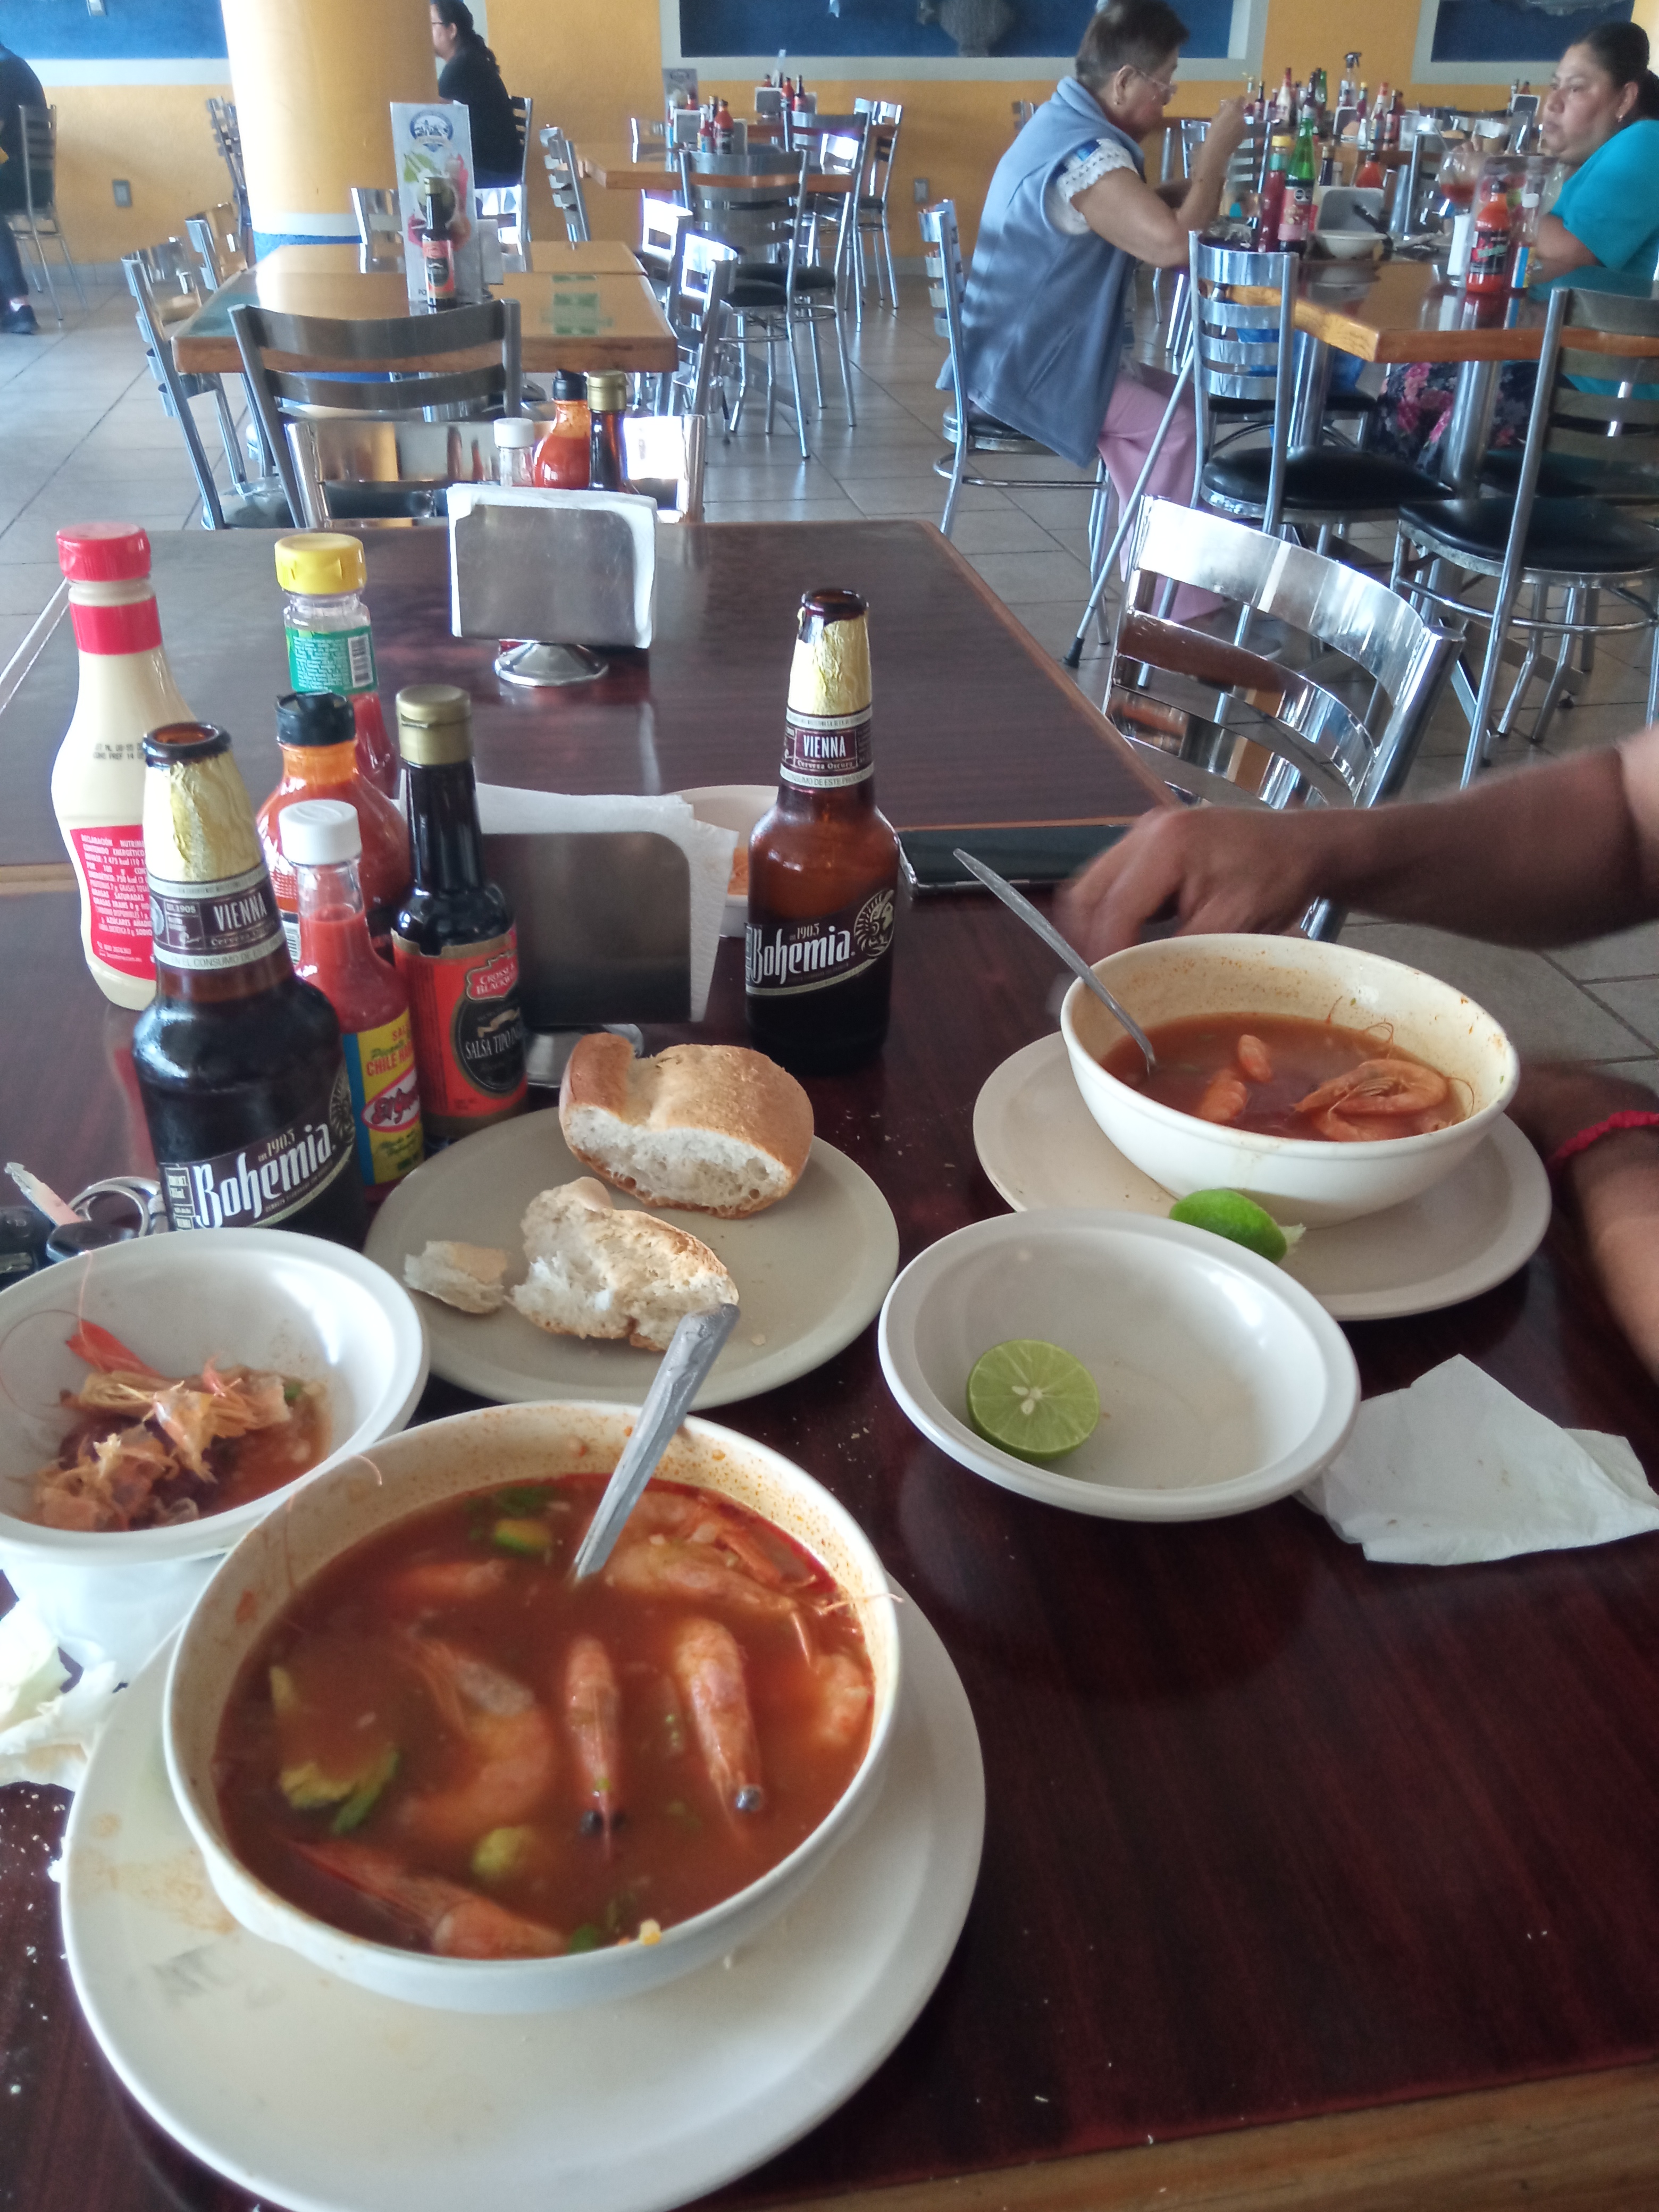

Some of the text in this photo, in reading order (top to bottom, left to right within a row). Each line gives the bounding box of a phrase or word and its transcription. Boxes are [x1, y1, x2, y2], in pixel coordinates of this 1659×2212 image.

[803, 734, 847, 758] VIENNA
[214, 892, 267, 931] VIENNA
[798, 923, 820, 940] 1905
[751, 926, 851, 985] Bohemia
[465, 1038, 492, 1060] SALSA
[366, 1053, 398, 1077] CHILE
[192, 1122, 333, 1229] Bohemia
